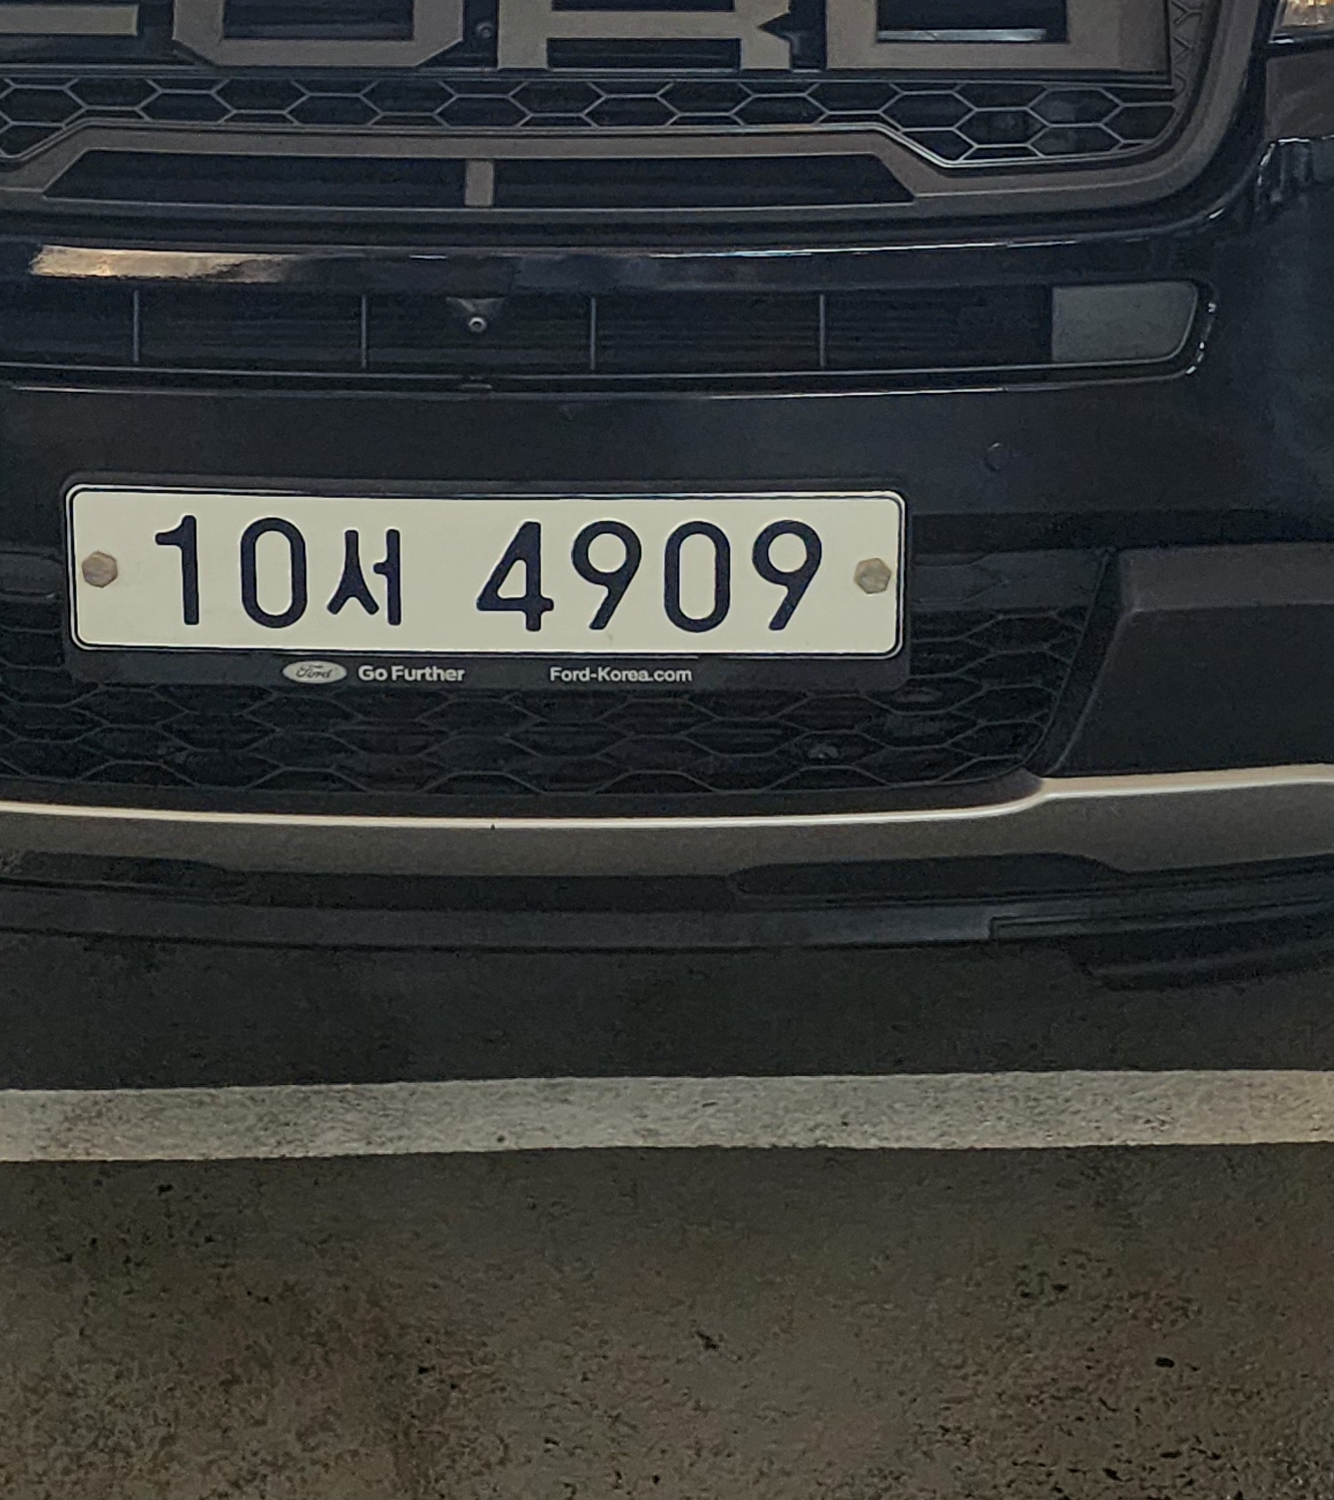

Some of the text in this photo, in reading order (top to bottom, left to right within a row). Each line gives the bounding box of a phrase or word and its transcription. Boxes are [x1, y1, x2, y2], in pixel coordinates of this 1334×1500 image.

[154, 514, 824, 632] 10서 4909
[357, 664, 466, 682] Go Further
[549, 666, 693, 683] Ford-Korea.com
